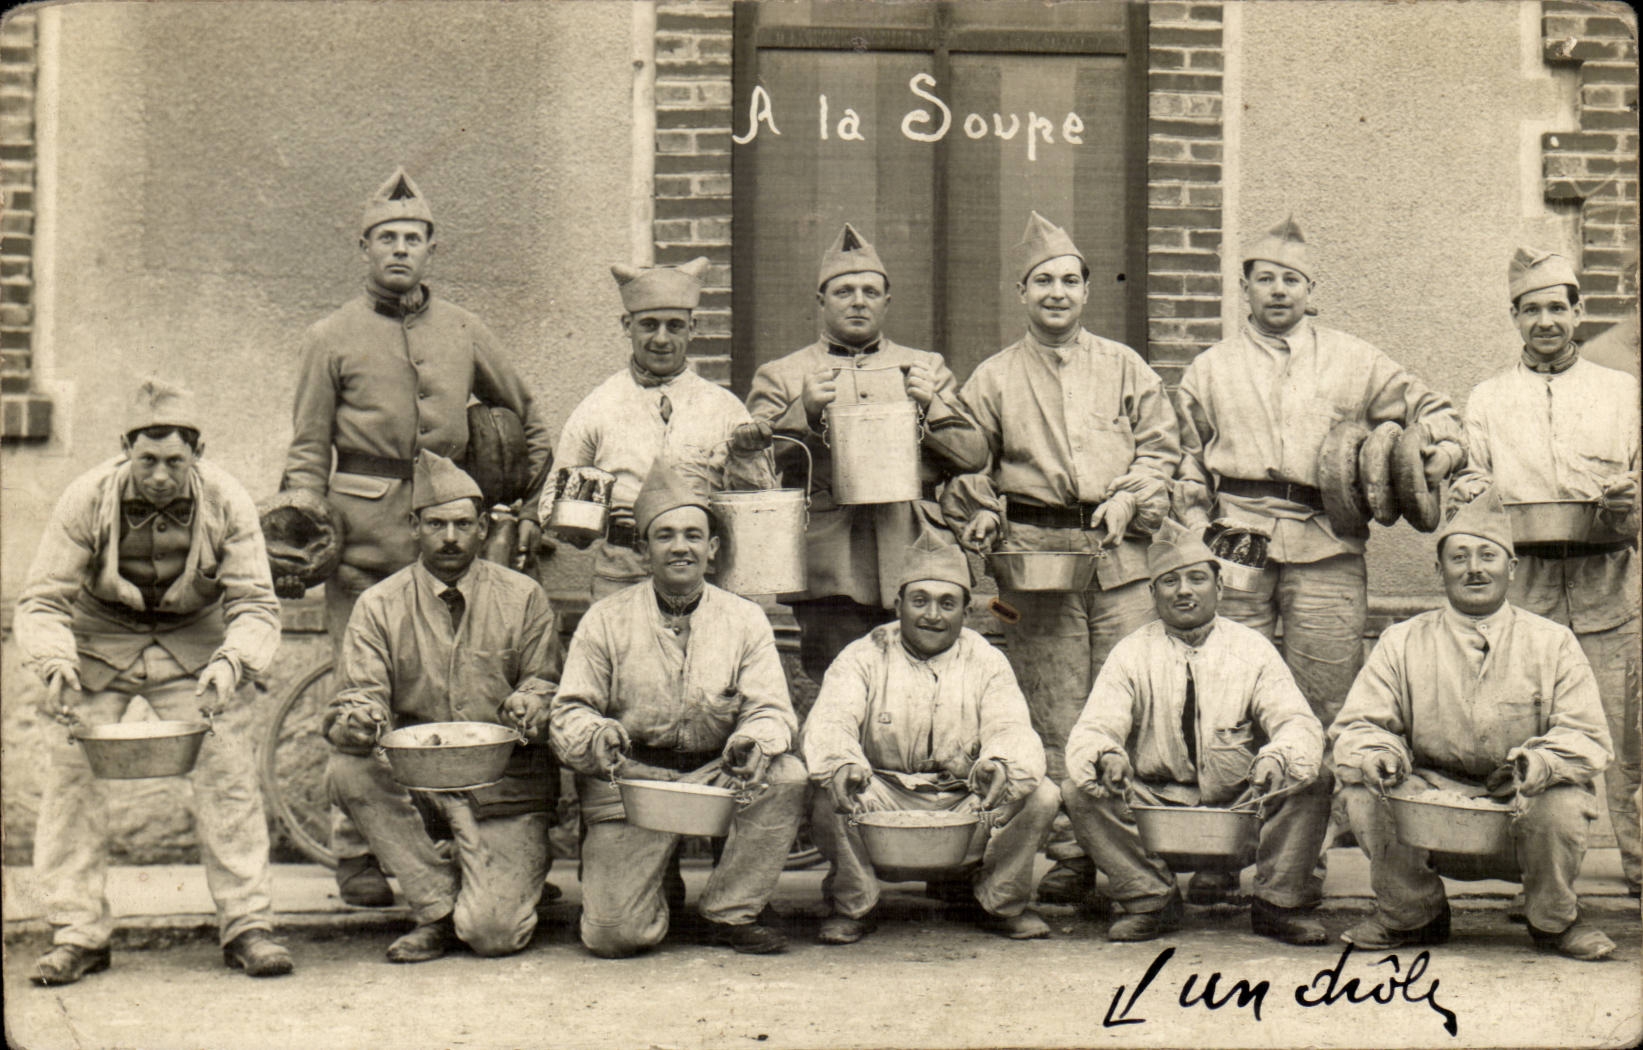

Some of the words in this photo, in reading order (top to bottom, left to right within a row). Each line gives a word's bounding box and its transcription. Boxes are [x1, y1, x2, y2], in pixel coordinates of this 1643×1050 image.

[732, 85, 781, 144] A
[819, 94, 865, 141] la
[901, 73, 1085, 162] Soupe
